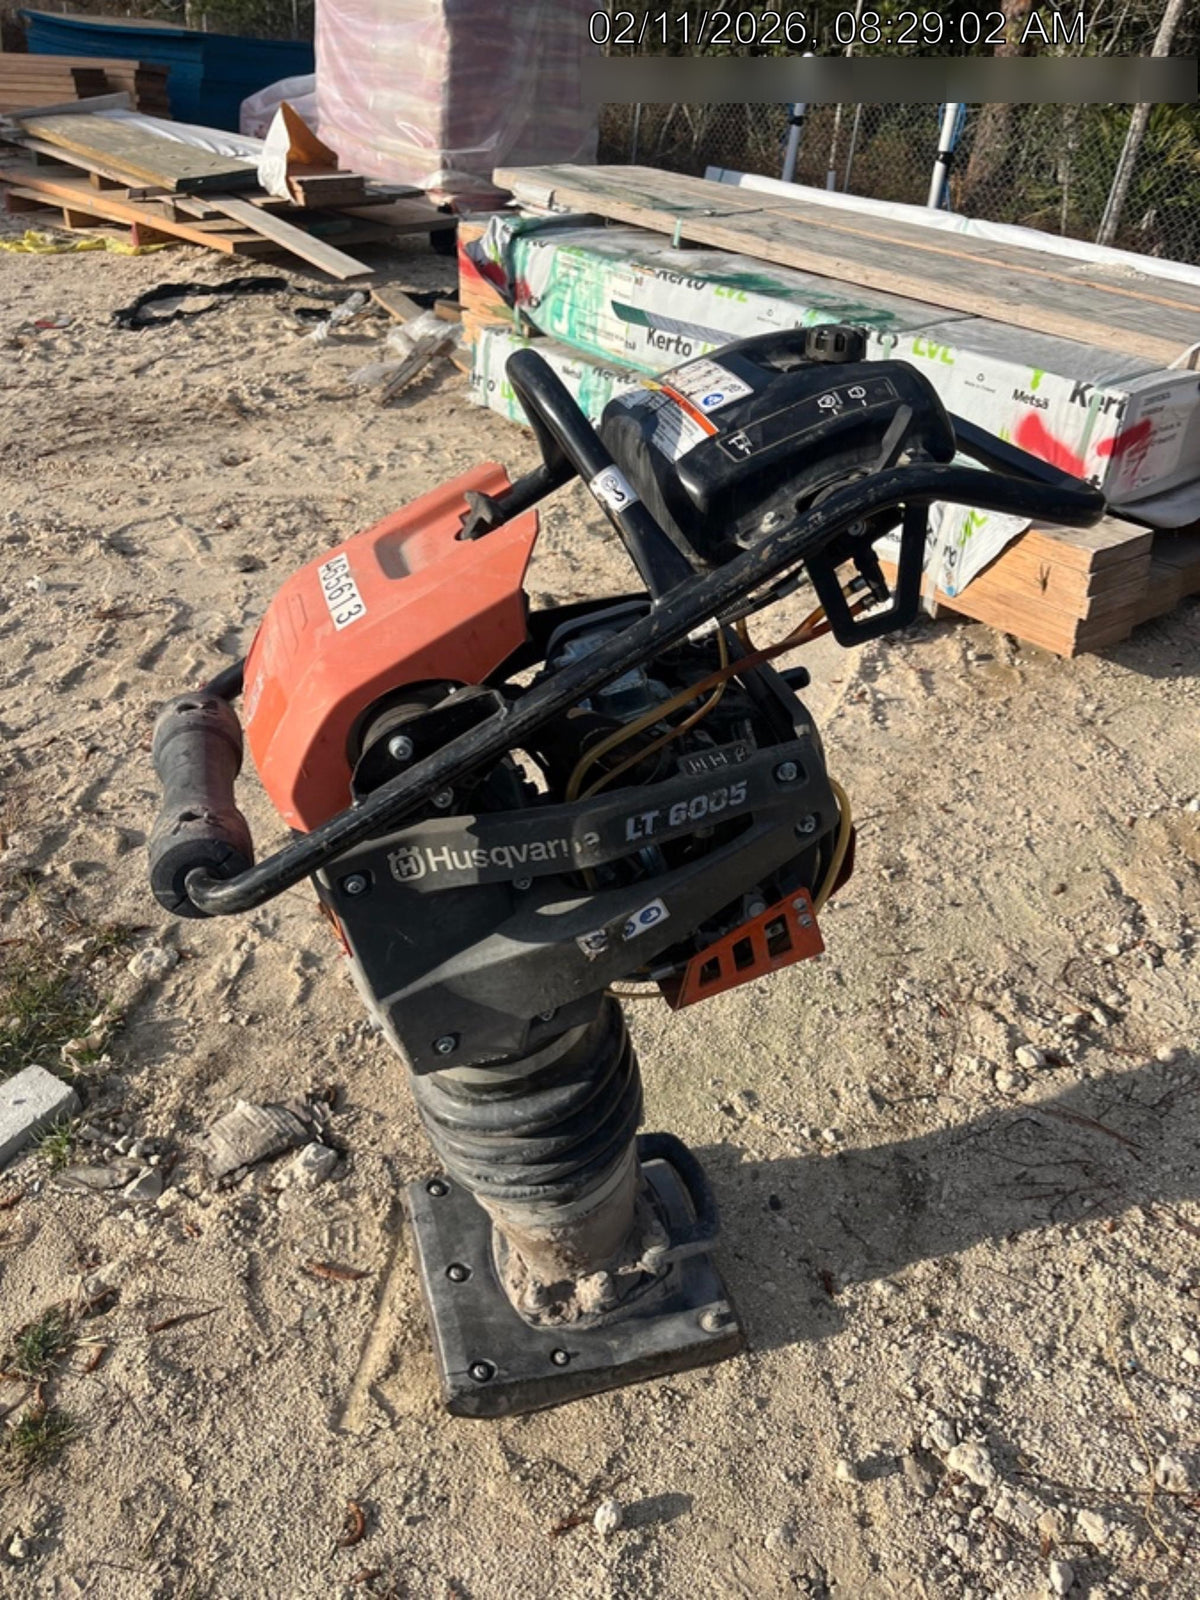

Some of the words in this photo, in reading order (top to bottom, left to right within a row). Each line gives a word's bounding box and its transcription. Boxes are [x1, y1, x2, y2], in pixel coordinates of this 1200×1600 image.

[646, 327, 693, 358] Kerto
[912, 336, 956, 366] LVL
[1012, 388, 1050, 411] Metsä
[625, 809, 661, 842] LT
